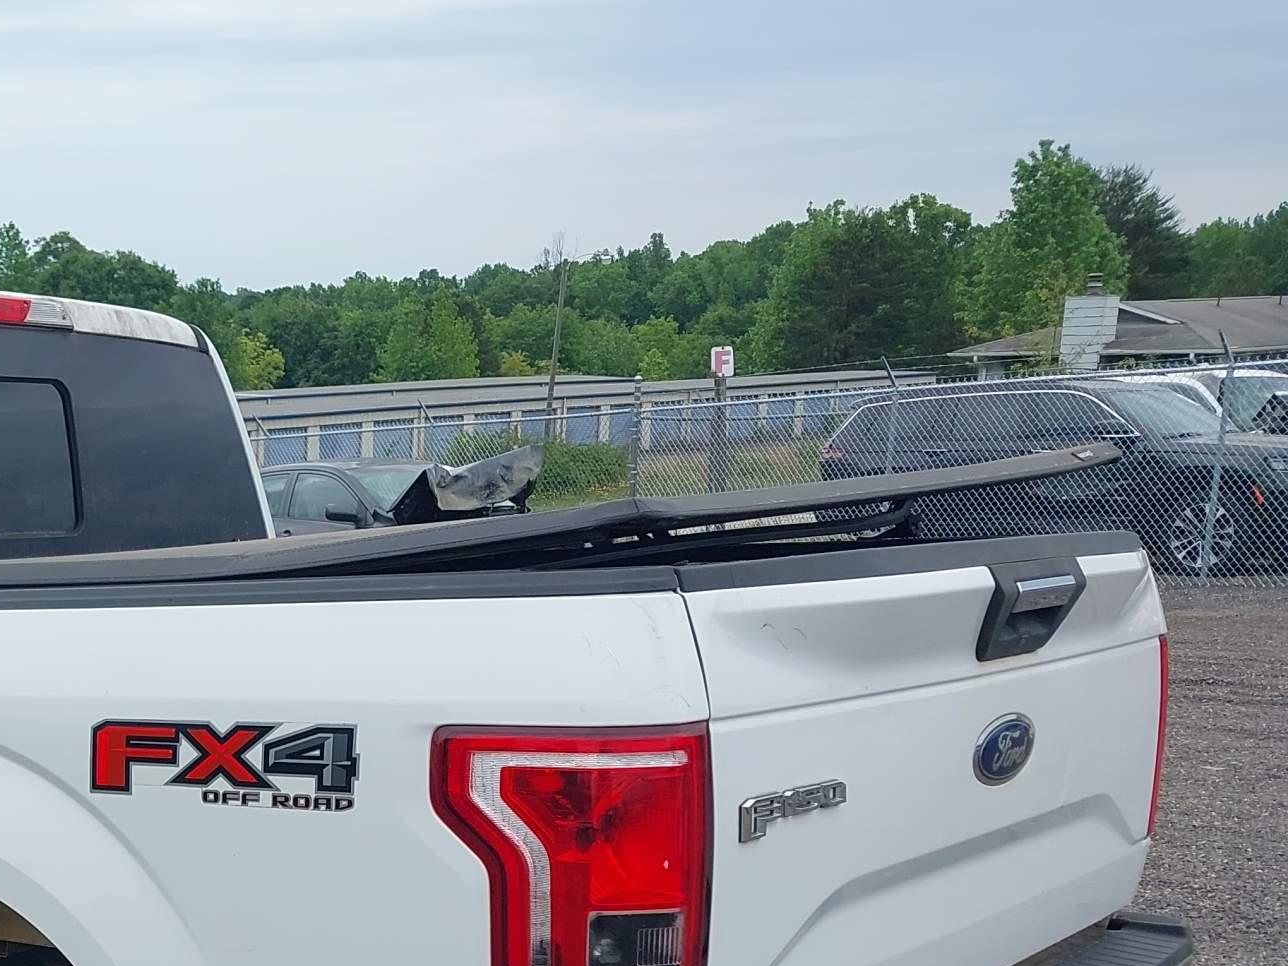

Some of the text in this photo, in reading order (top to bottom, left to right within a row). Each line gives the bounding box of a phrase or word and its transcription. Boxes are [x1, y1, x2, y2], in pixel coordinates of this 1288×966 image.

[714, 350, 732, 373] F
[90, 718, 360, 796] FX4
[201, 788, 355, 812] OFF ROAD
